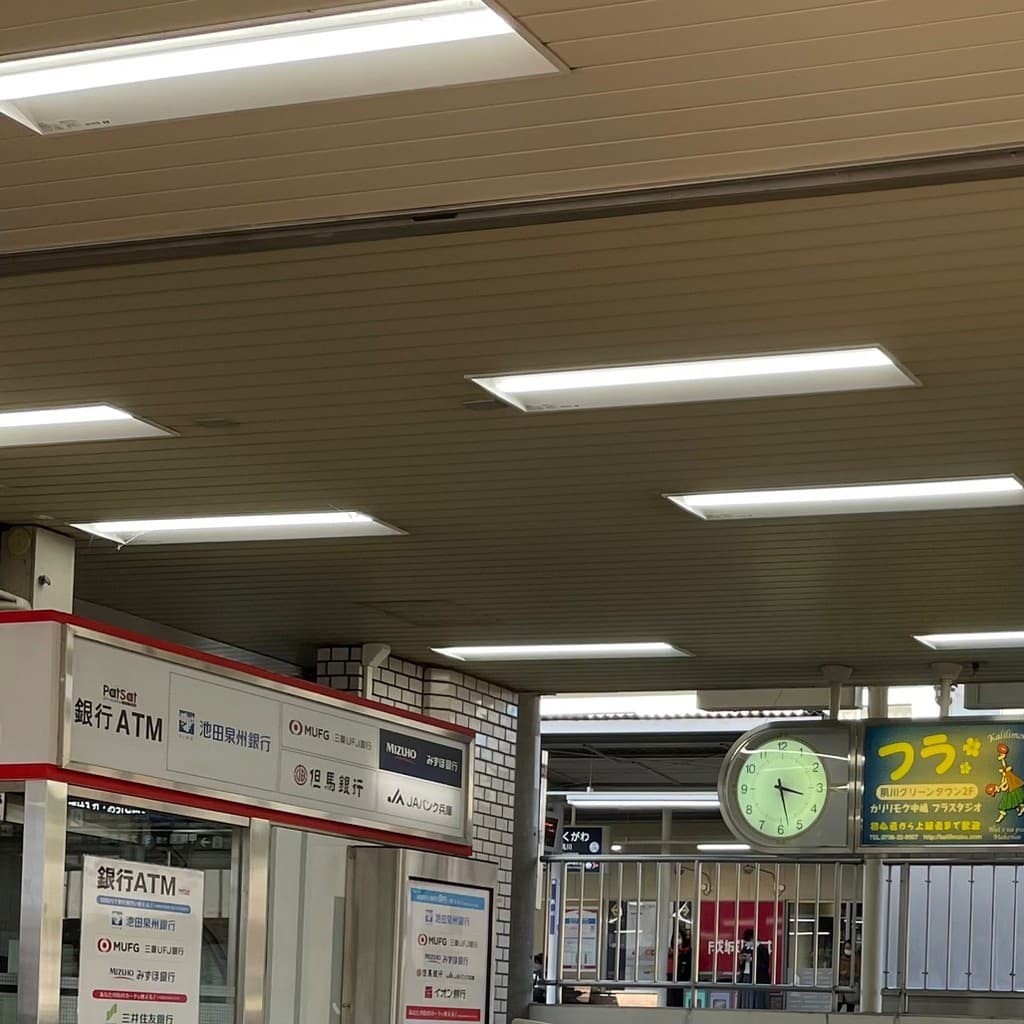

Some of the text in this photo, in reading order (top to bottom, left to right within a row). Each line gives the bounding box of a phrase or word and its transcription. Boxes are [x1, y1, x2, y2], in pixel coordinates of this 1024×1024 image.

[199, 720, 271, 753] 池田泉州銀行
[304, 725, 330, 741] MUFG
[386, 742, 458, 773] MIZUHO みずほ銀行
[878, 733, 956, 781] フラ
[745, 764, 756, 774] 10
[812, 762, 820, 773] 2
[310, 768, 364, 798] 但馬銀行
[816, 782, 824, 793] 3
[740, 784, 748, 794] 9
[745, 805, 753, 815] 8
[810, 804, 817, 813] 4
[759, 820, 765, 830] 7
[777, 825, 785, 835] 6
[796, 820, 804, 830] 5
[562, 831, 590, 842] くがわ
[96, 865, 176, 896] 銀行ATM
[126, 916, 176, 931] 池田泉州銀行
[428, 936, 447, 946] MUFG
[113, 941, 140, 953] MUFG
[136, 969, 176, 983] みずほ銀行
[121, 1013, 174, 1024] 三井住友銀行
